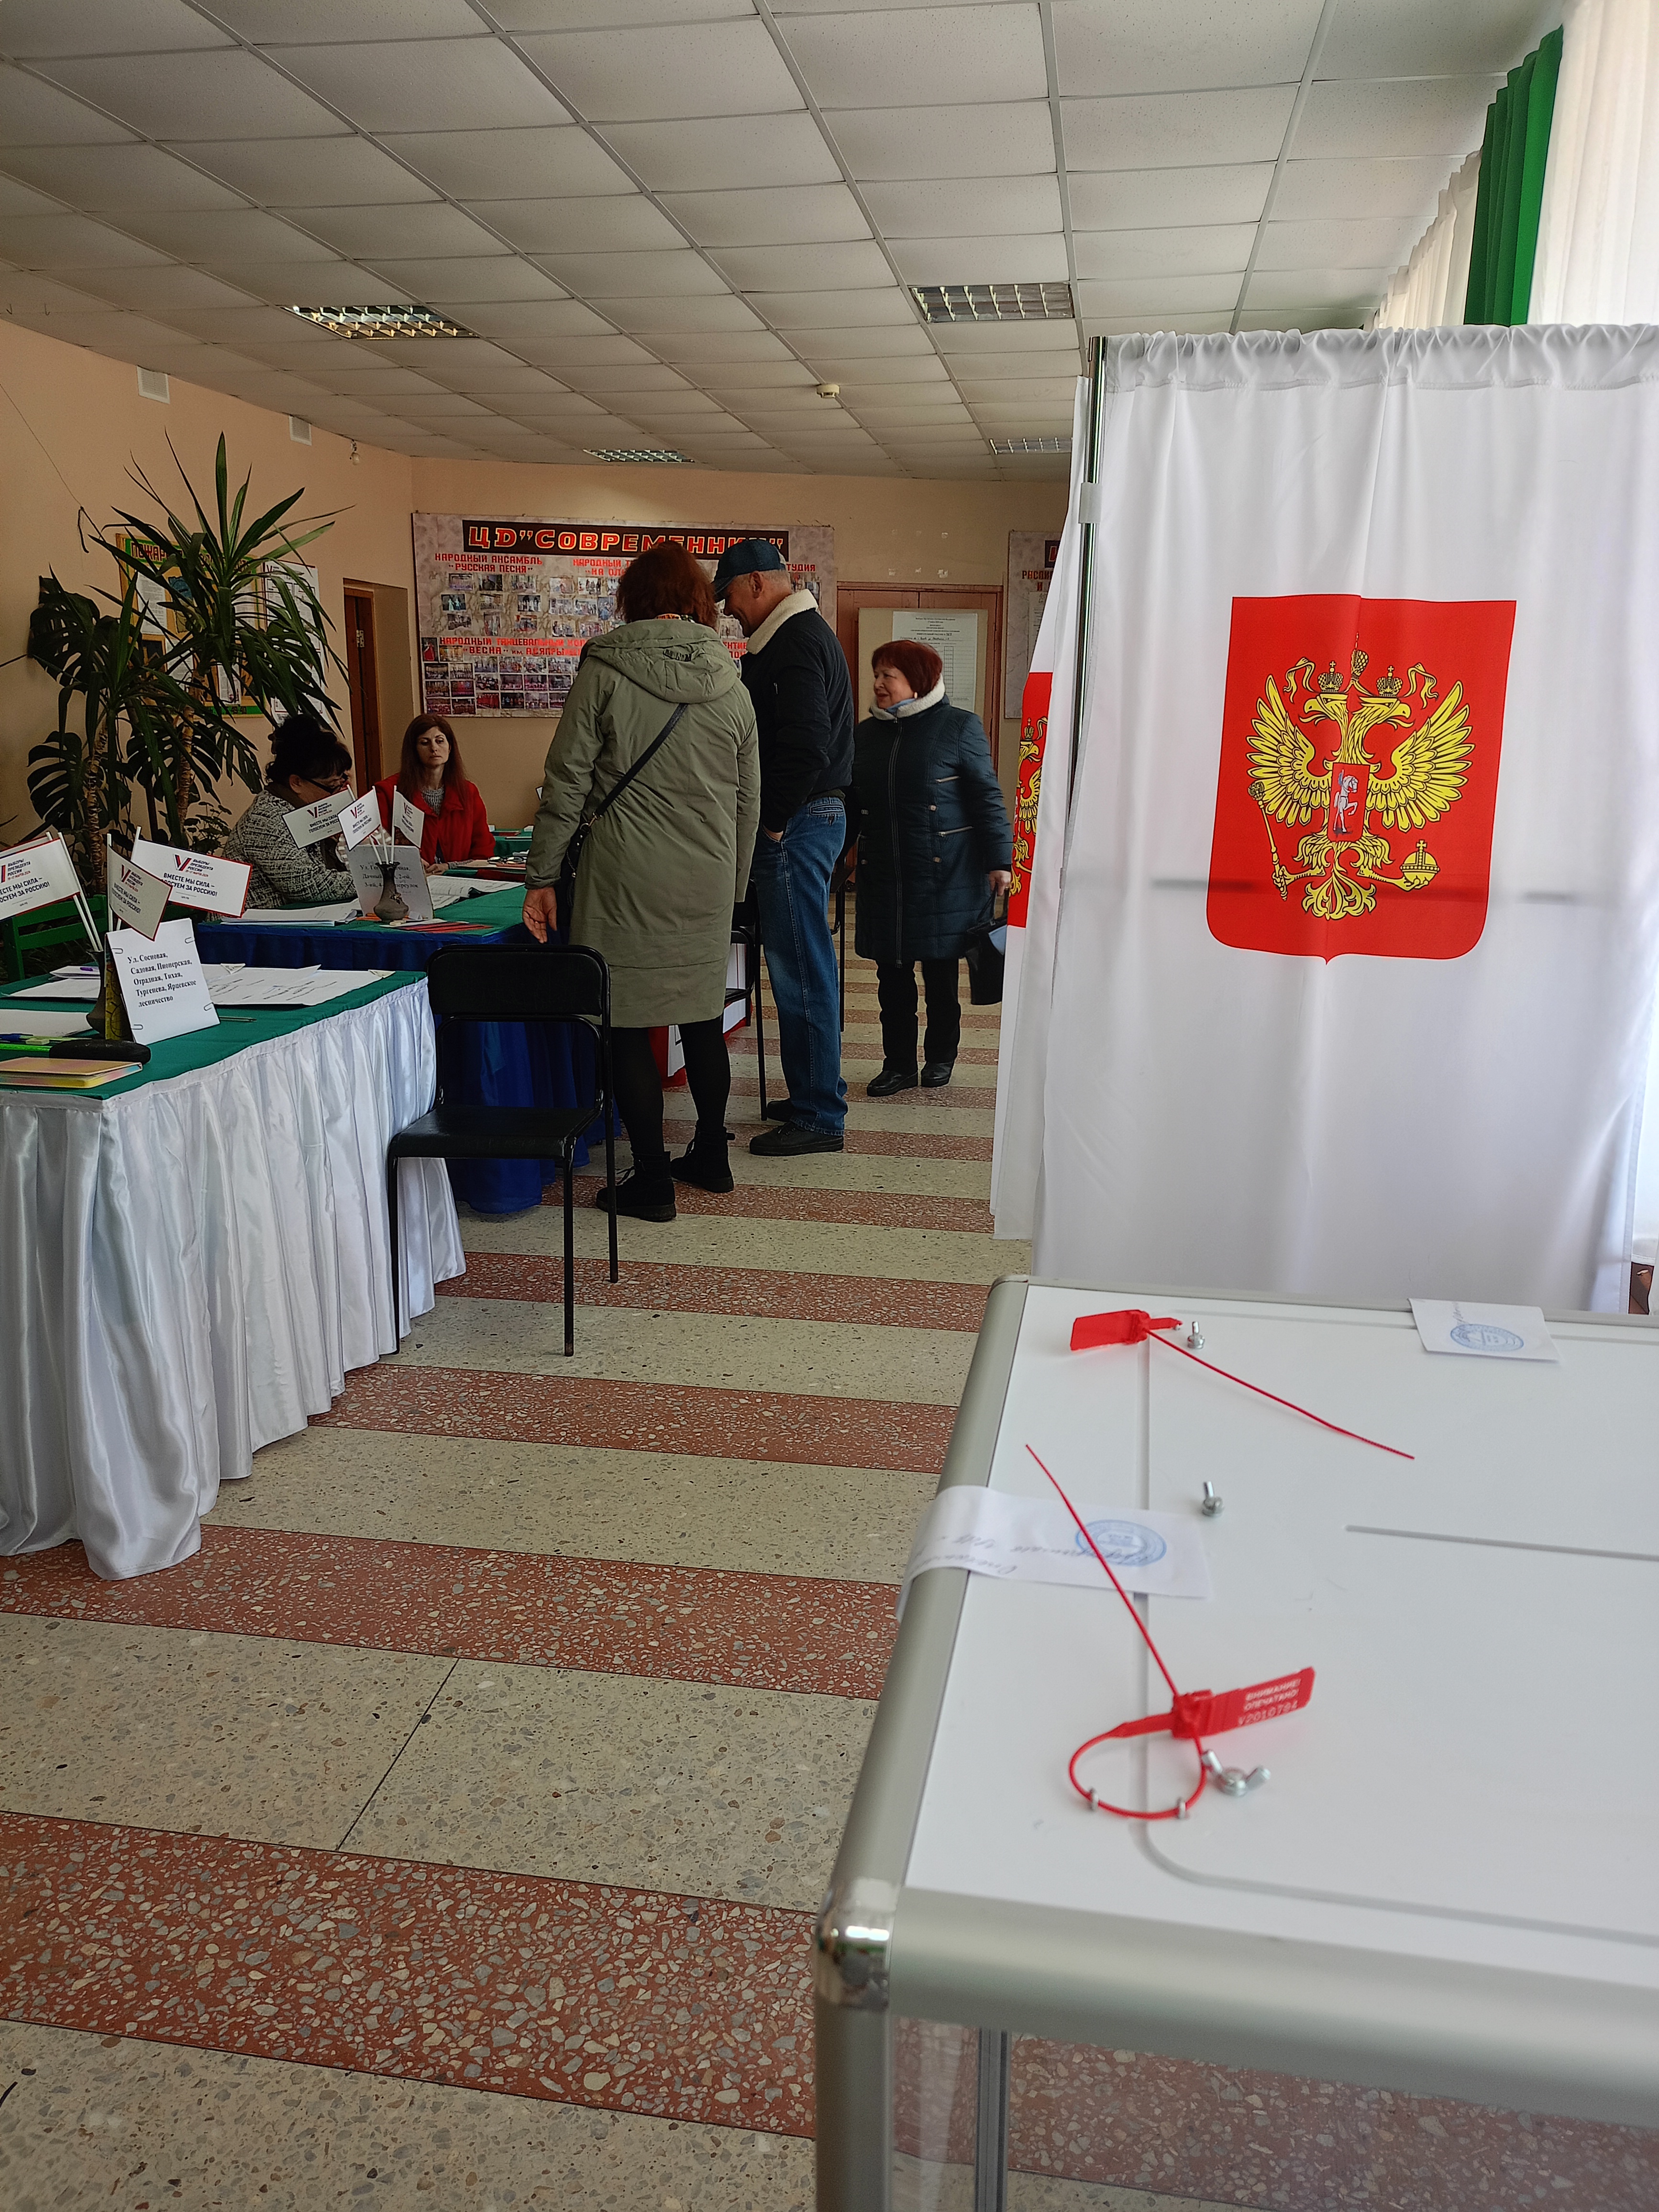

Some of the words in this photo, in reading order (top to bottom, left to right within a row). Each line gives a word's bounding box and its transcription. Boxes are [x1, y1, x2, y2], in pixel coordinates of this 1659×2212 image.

[435, 553, 487, 563] НАРОДНЫЙ
[491, 555, 542, 565] АНСАМБЛЬ
[573, 559, 621, 567] НАРОДНЫЙ
[786, 564, 816, 572] ТУДИЯ
[8, 859, 24, 867] ВЫБОРЫ
[8, 861, 31, 872] ПРЕЗИДЕНТА
[190, 863, 213, 871] ПРЕЗИДЕНТА
[164, 873, 185, 882] ВМЕСТЕ
[0, 886, 12, 895] ЕСТЕ
[12, 882, 23, 890] МЫ
[23, 877, 38, 886] СИЛА
[193, 886, 218, 896] РОССИЮ!
[0, 892, 17, 903] ОСУЕМ
[25, 881, 50, 894] РОССИЮ!
[139, 953, 168, 962] Сосновая,
[131, 965, 156, 975] Садовая,
[157, 960, 192, 970] Пионерская,
[133, 976, 163, 986] Отрадная,
[135, 986, 167, 997] Тургенева,
[167, 980, 197, 991] Ярцевское
[138, 996, 173, 1007] лесничество
